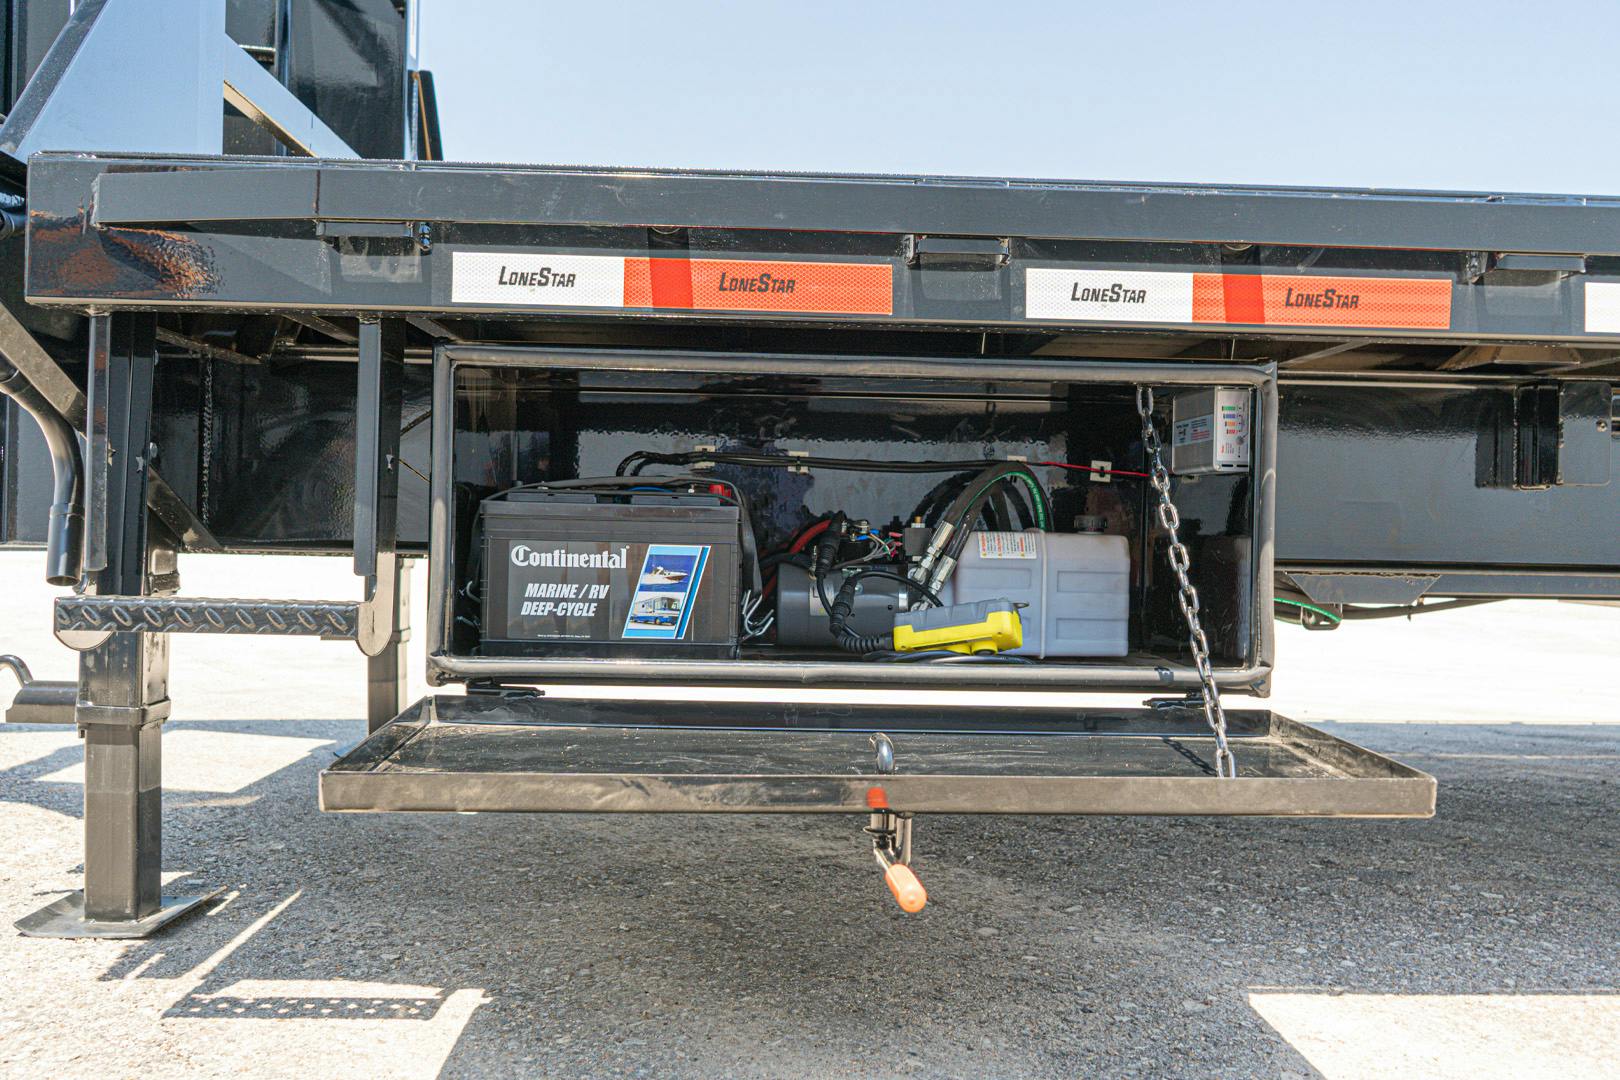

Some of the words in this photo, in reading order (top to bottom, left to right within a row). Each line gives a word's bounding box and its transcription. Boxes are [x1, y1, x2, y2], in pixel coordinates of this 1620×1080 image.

[511, 545, 627, 569] Continental
[524, 583, 579, 599] MARINE
[589, 584, 610, 600] RV
[521, 601, 598, 617] DEEP-CYCLE
